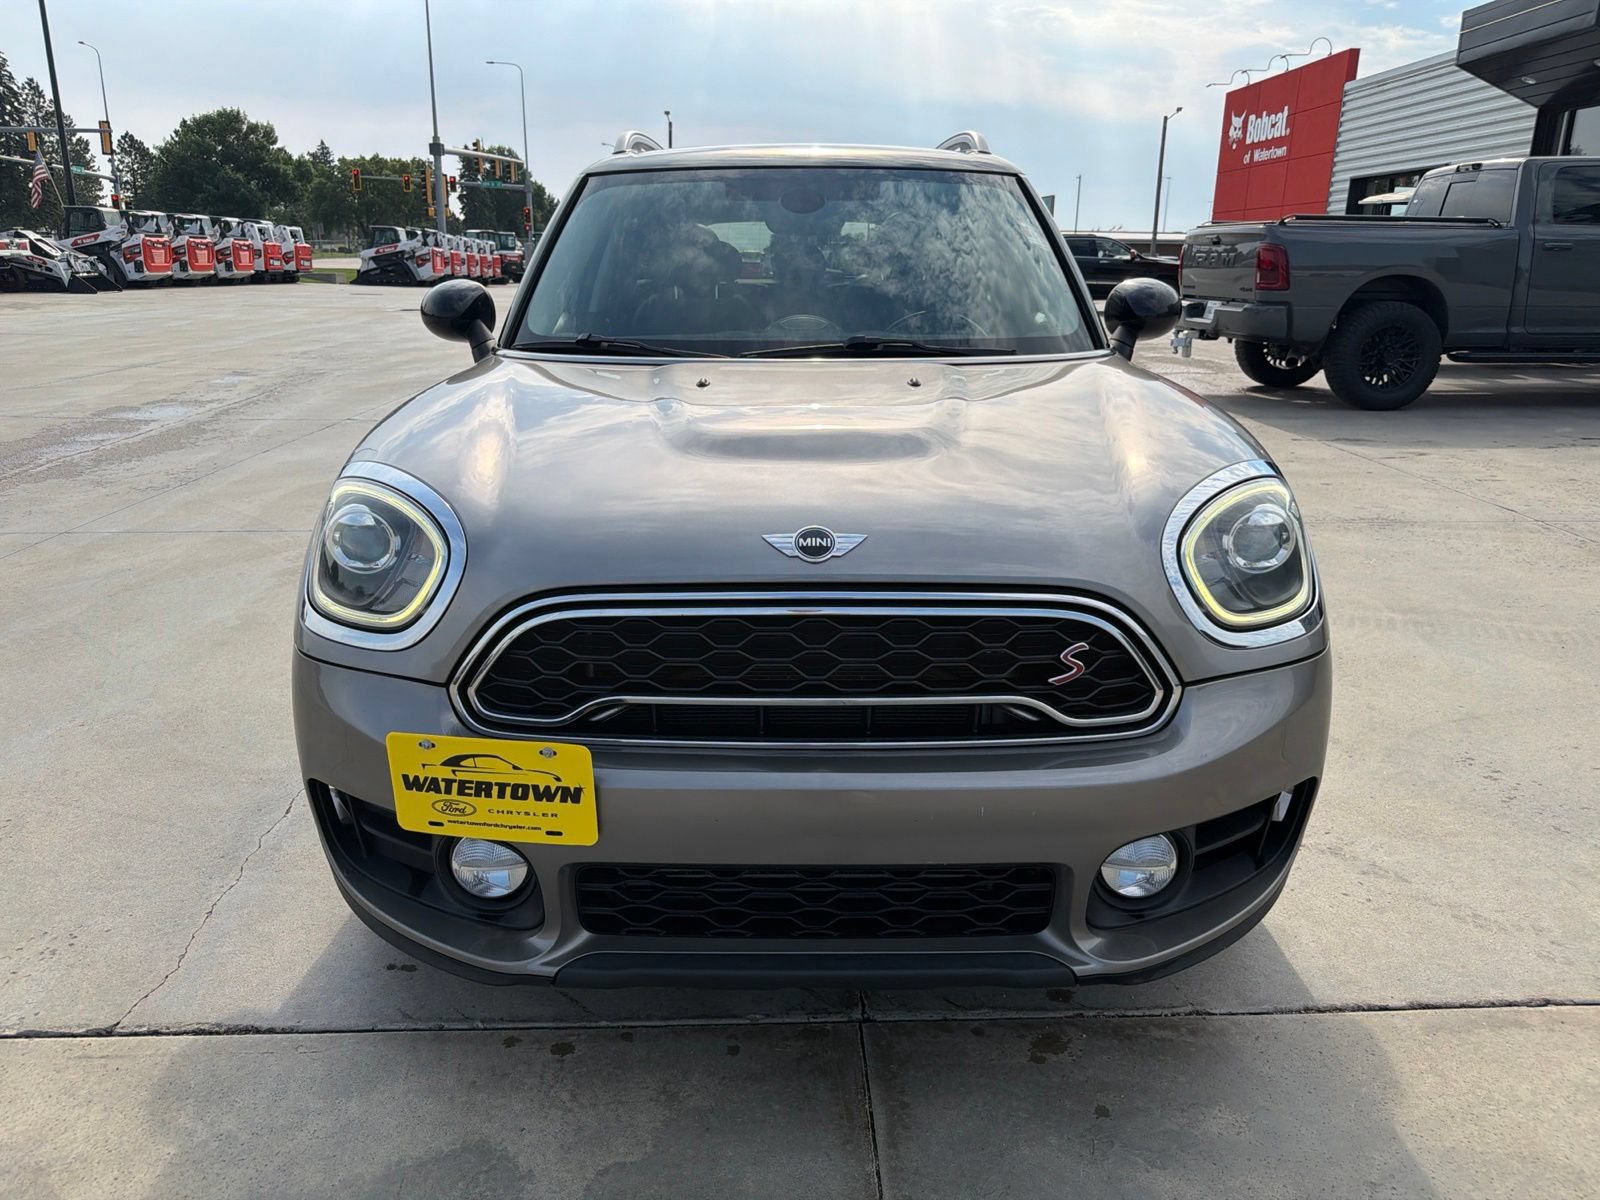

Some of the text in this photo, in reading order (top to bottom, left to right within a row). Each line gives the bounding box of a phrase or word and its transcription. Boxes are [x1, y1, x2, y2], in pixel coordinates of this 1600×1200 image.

[1243, 146, 1287, 164] of Watertown
[799, 537, 831, 547] MINI
[1048, 642, 1089, 685] S
[401, 773, 582, 804] WATERTOWN
[441, 801, 559, 818] Ford CHRYSLER
[447, 819, 542, 831] watertownfordchrysler.com
